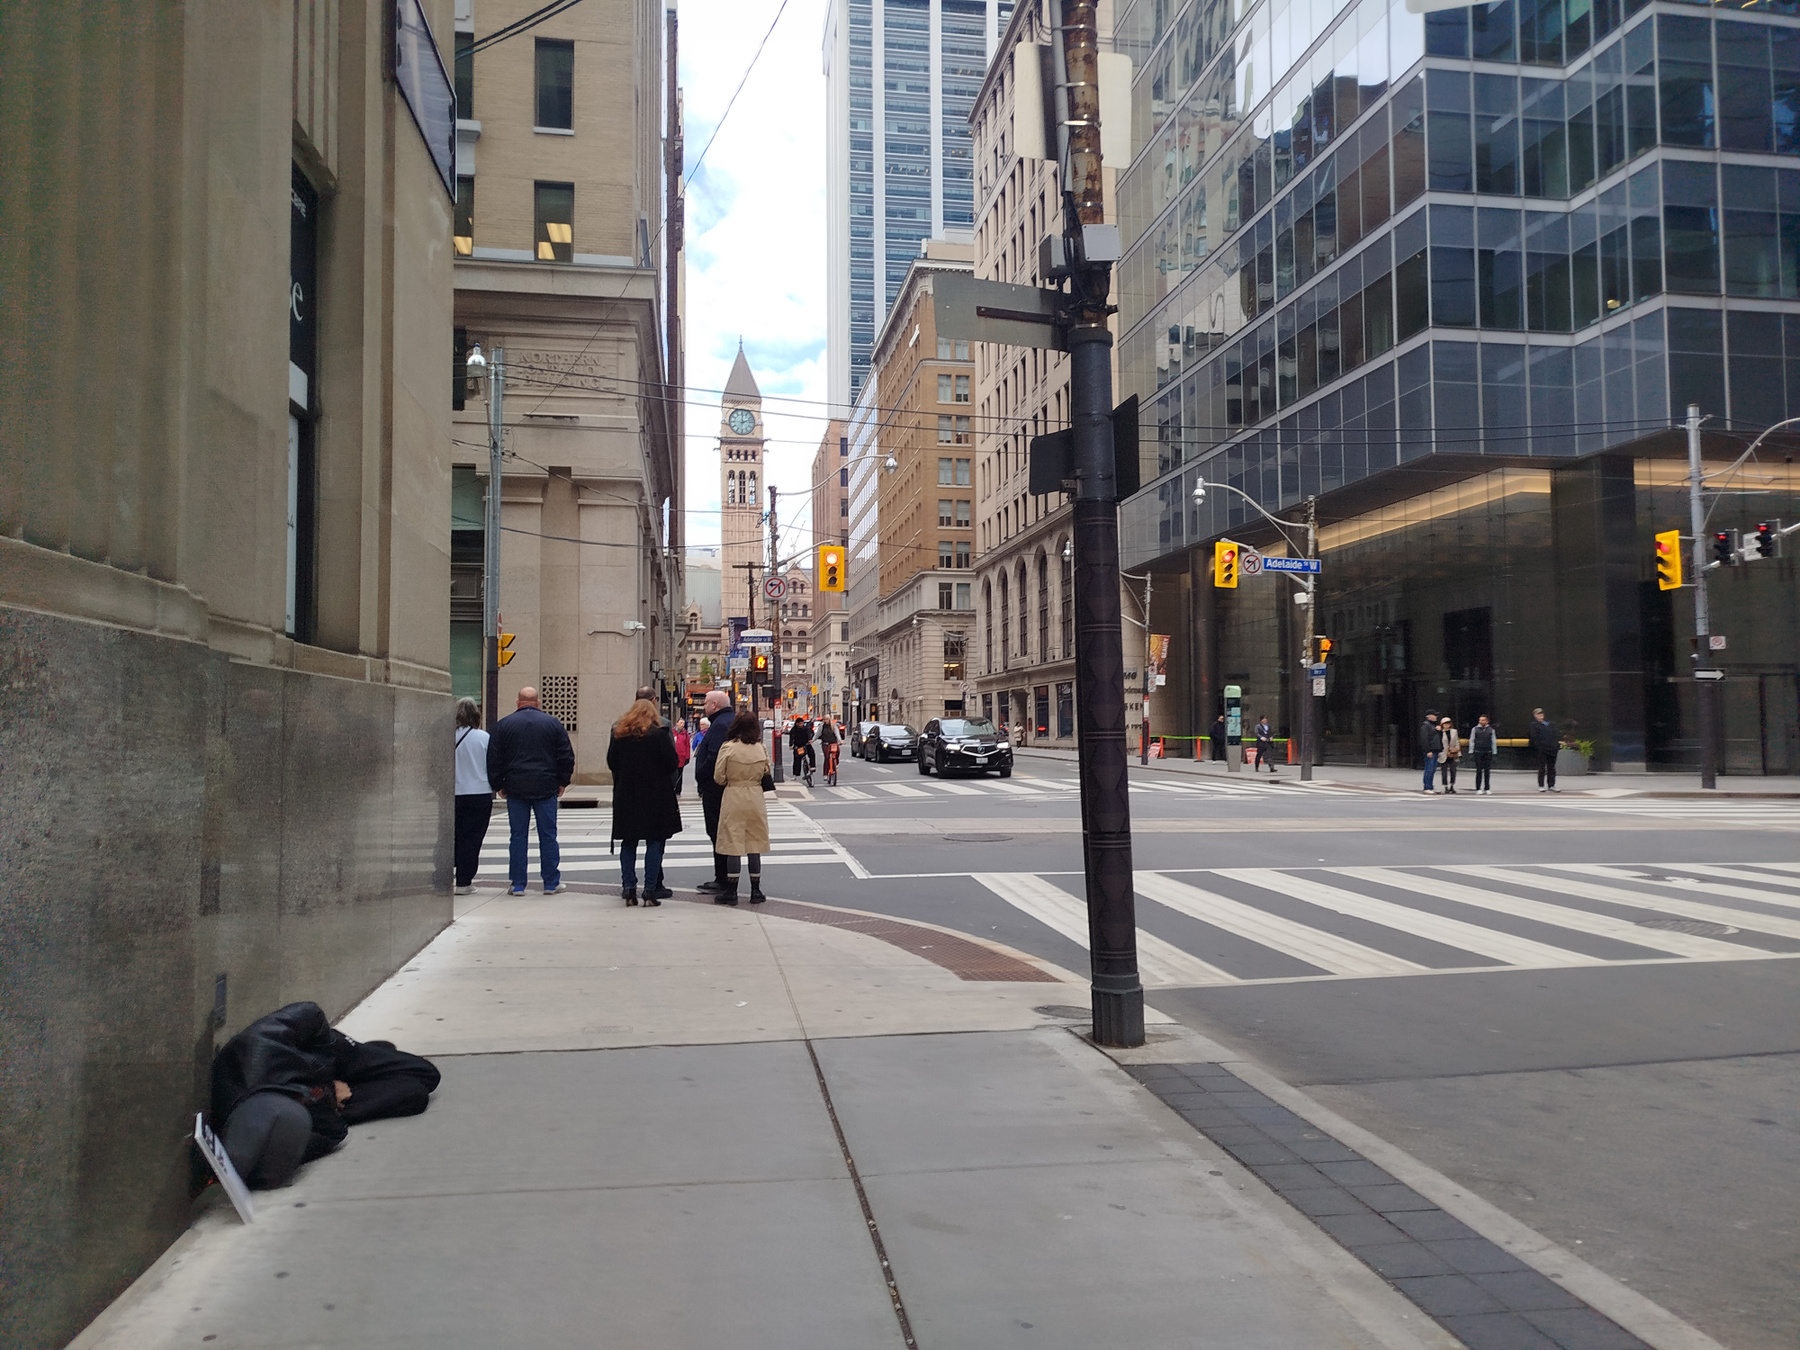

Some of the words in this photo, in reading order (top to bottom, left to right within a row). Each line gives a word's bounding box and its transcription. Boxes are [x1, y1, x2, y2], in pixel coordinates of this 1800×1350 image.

[517, 351, 601, 366] NORTHERN
[1266, 558, 1303, 569] Adelaide
[1309, 561, 1318, 570] W
